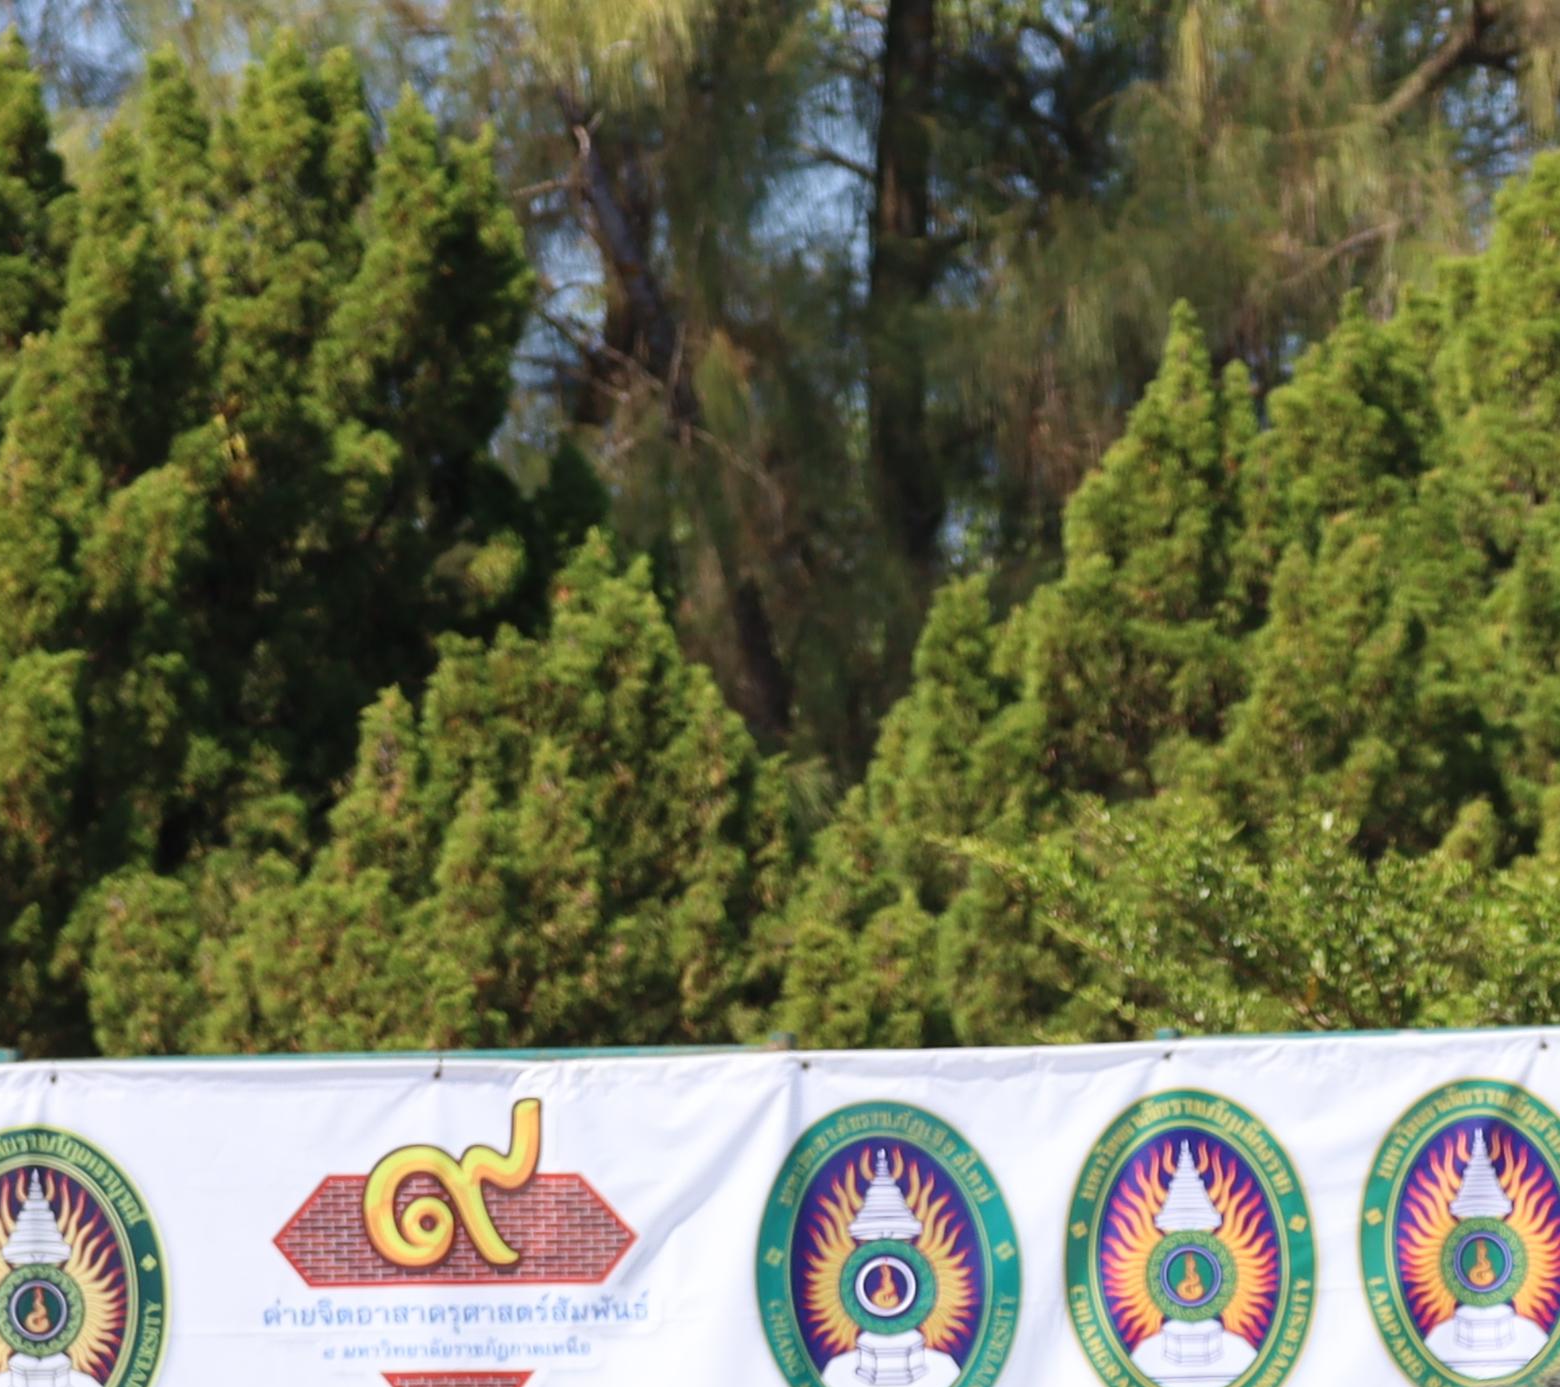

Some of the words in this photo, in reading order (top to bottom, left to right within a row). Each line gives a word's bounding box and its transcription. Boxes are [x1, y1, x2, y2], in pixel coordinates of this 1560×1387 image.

[261, 1289, 651, 1334] ค่ายจิตอาสาครุศาสตร์สัมพันธ์
[1366, 1275, 1427, 1379] LAMPANG
